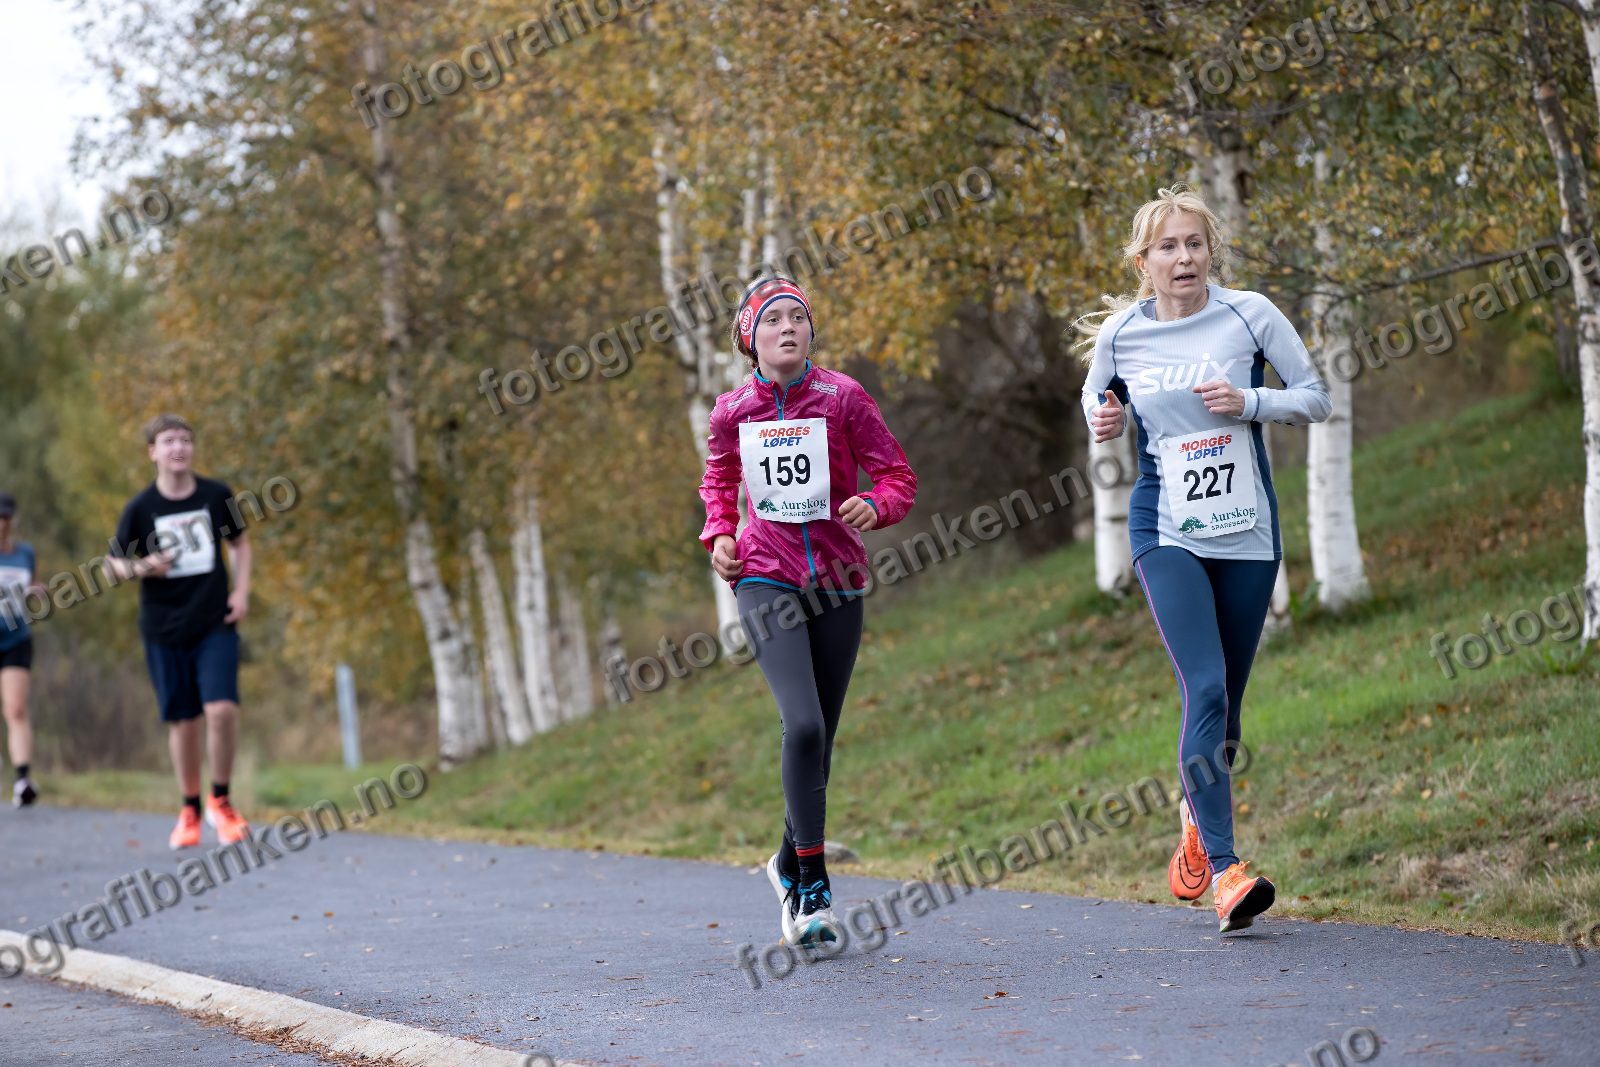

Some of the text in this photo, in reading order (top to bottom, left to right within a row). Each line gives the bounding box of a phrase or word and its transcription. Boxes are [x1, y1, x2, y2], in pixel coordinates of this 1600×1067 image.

[759, 426, 811, 438] NORGES
[763, 436, 803, 449] LØPET
[1180, 434, 1233, 453] NORGES
[1187, 445, 1226, 462] LØPET
[759, 453, 811, 487] 159
[1183, 462, 1236, 502] 227
[781, 498, 827, 511] Aurskog
[1211, 507, 1256, 522] Aurskog
